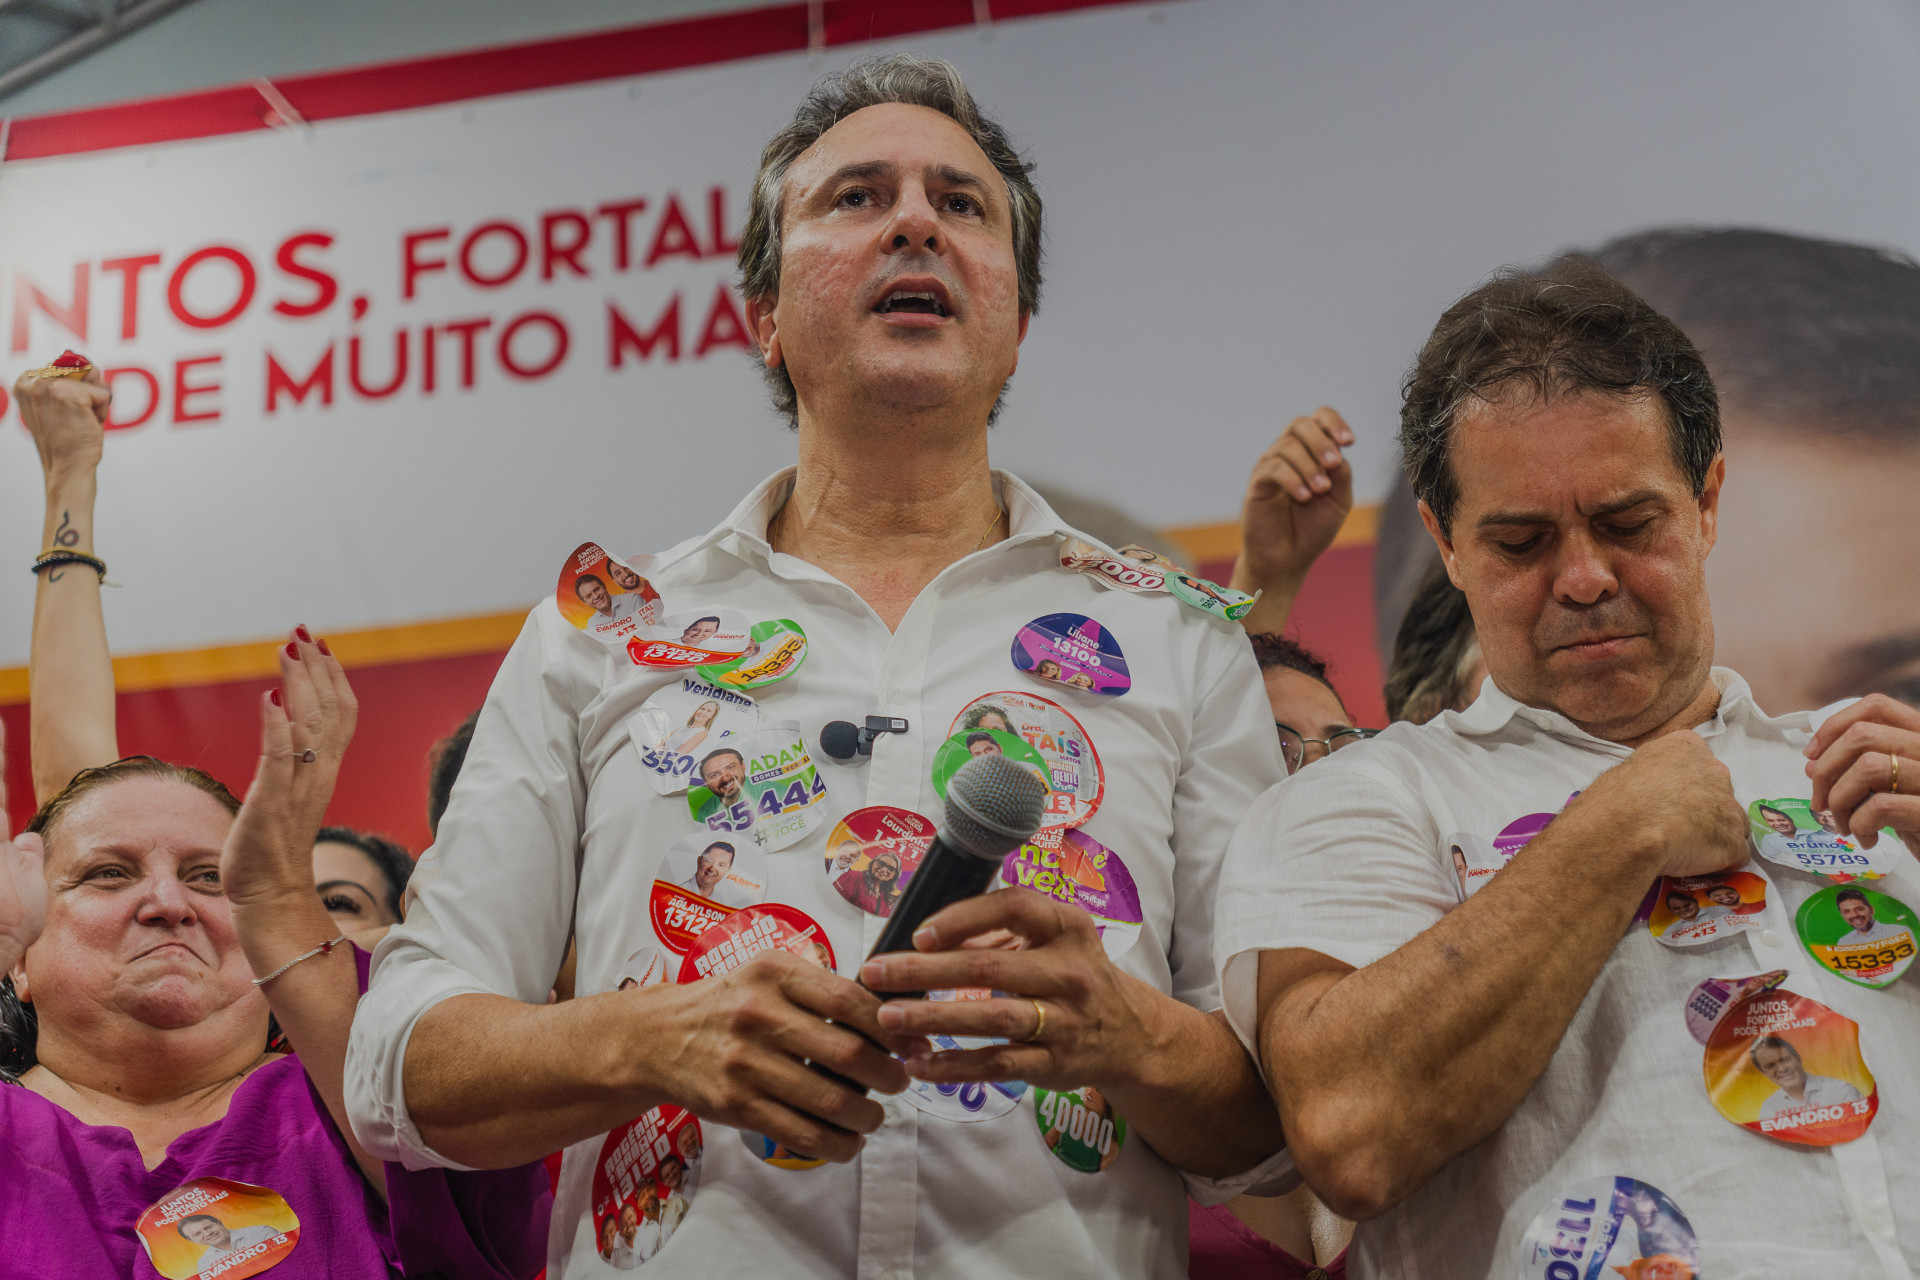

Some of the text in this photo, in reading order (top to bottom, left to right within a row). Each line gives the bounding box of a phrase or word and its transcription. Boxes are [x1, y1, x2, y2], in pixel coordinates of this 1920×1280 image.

[264, 310, 572, 416] MUITO
[596, 616, 632, 633] EVANDRO
[740, 638, 804, 682] 15333
[1052, 636, 1101, 668] 13100
[683, 679, 752, 707] Veridiana
[1021, 723, 1045, 732] Dra.
[750, 738, 807, 775] ADAM
[1059, 754, 1081, 765] MATOS
[706, 771, 827, 832] 55444
[1786, 840, 1841, 850] Bruno
[1796, 853, 1870, 866] 55789
[668, 898, 726, 922] AGLAYLSON
[1671, 919, 1715, 939] EVANDRO
[1701, 925, 1717, 937] 13
[694, 914, 778, 973] ROGÉRIO
[1830, 942, 1915, 971] 15333
[1857, 964, 1893, 977] Vereador
[1746, 1011, 1797, 1026] FORTALEZA
[1747, 1000, 1793, 1015] JUNTOS,
[1733, 1017, 1816, 1036] PODE MUITO MAIS
[1039, 1089, 1114, 1155] 40000
[1760, 1105, 1844, 1132] EVANDRO
[1852, 1099, 1870, 1116] 13
[612, 1133, 671, 1211] 13130
[154, 1190, 229, 1228] PODE MUITO MAIS
[160, 1187, 207, 1214] JUNTOS,
[163, 1192, 212, 1218] FORTALEZA
[199, 1233, 289, 1280] EVANDRO 13
